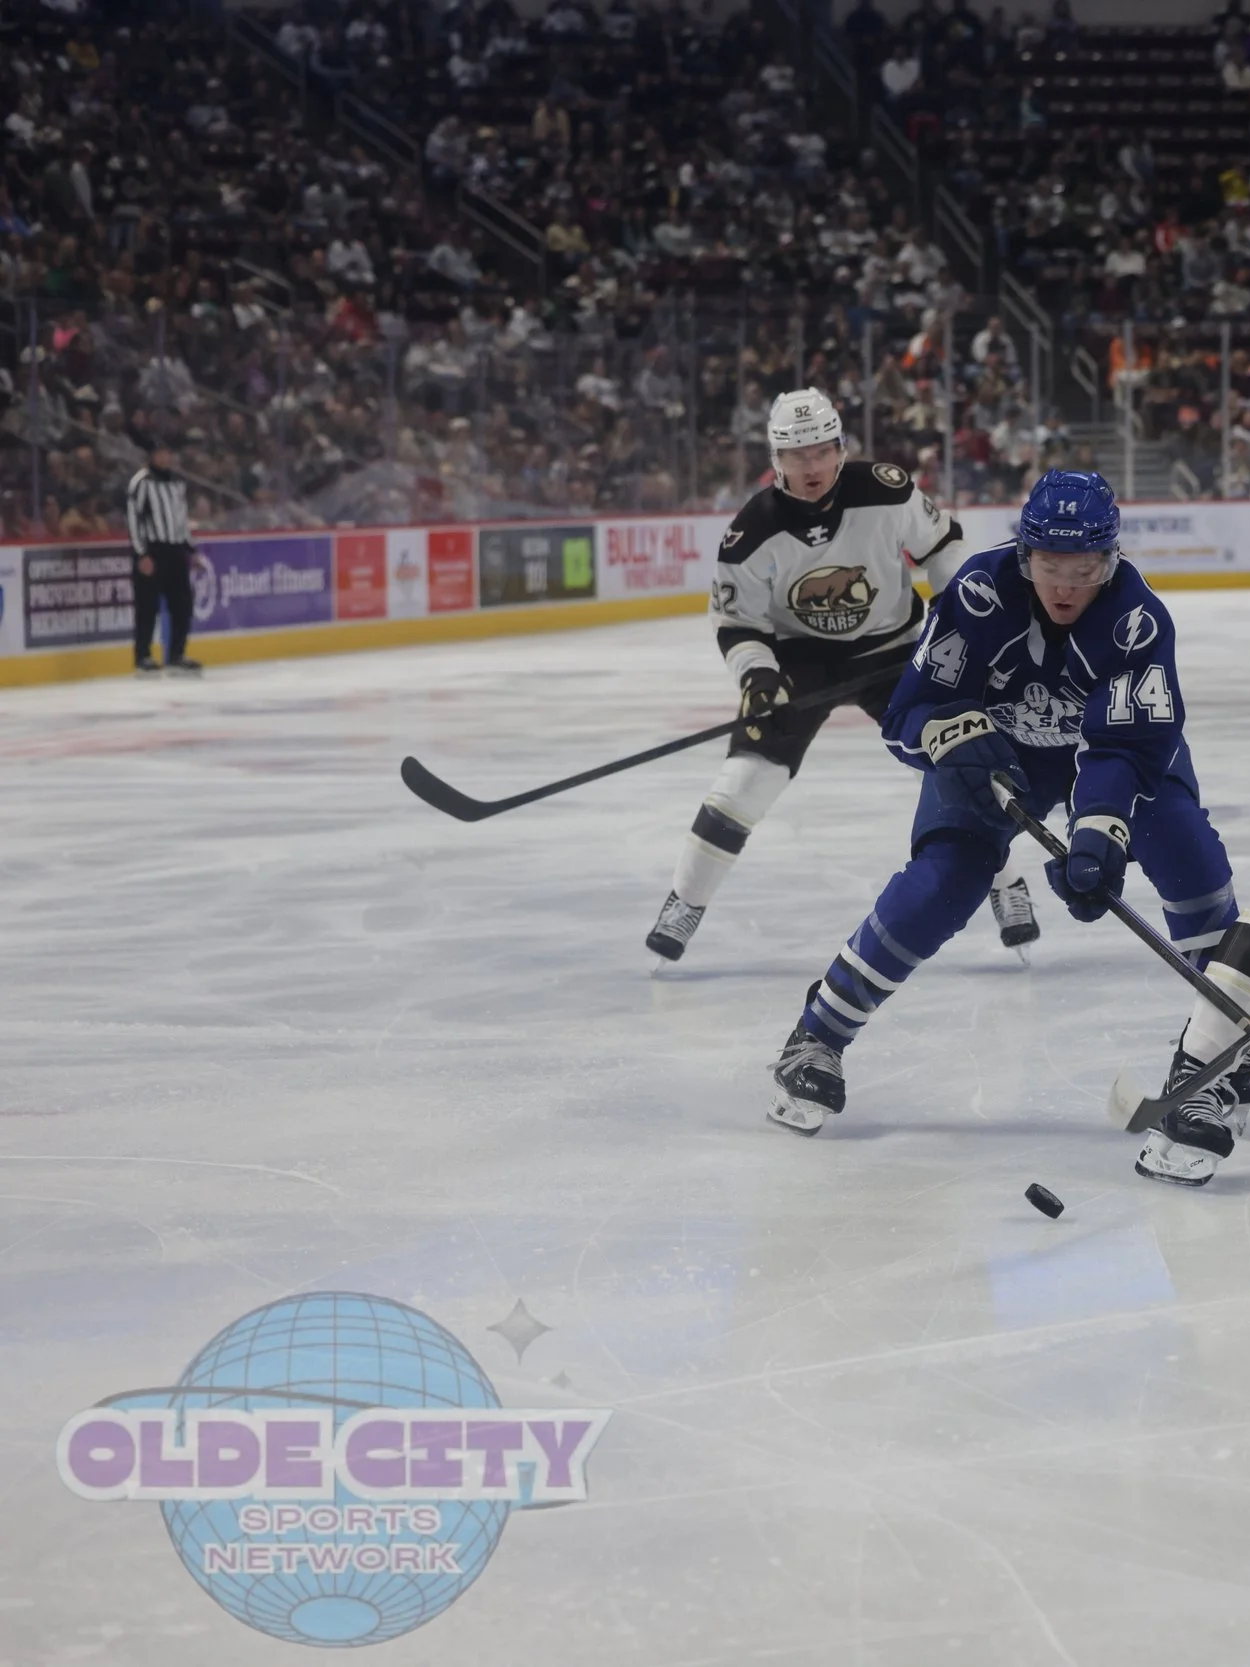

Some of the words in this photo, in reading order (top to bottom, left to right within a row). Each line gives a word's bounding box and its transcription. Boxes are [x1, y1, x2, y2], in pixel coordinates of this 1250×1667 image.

[794, 405, 812, 418] 92
[1057, 500, 1077, 515] 14
[1048, 528, 1084, 537] CCM
[221, 565, 271, 608] planet
[272, 561, 325, 595] fitness
[712, 579, 738, 616] 92
[807, 614, 858, 632] BEARS
[912, 614, 969, 689] 14
[1106, 664, 1175, 726] 14
[928, 717, 990, 758] CCM
[1189, 1158, 1204, 1168] CCM
